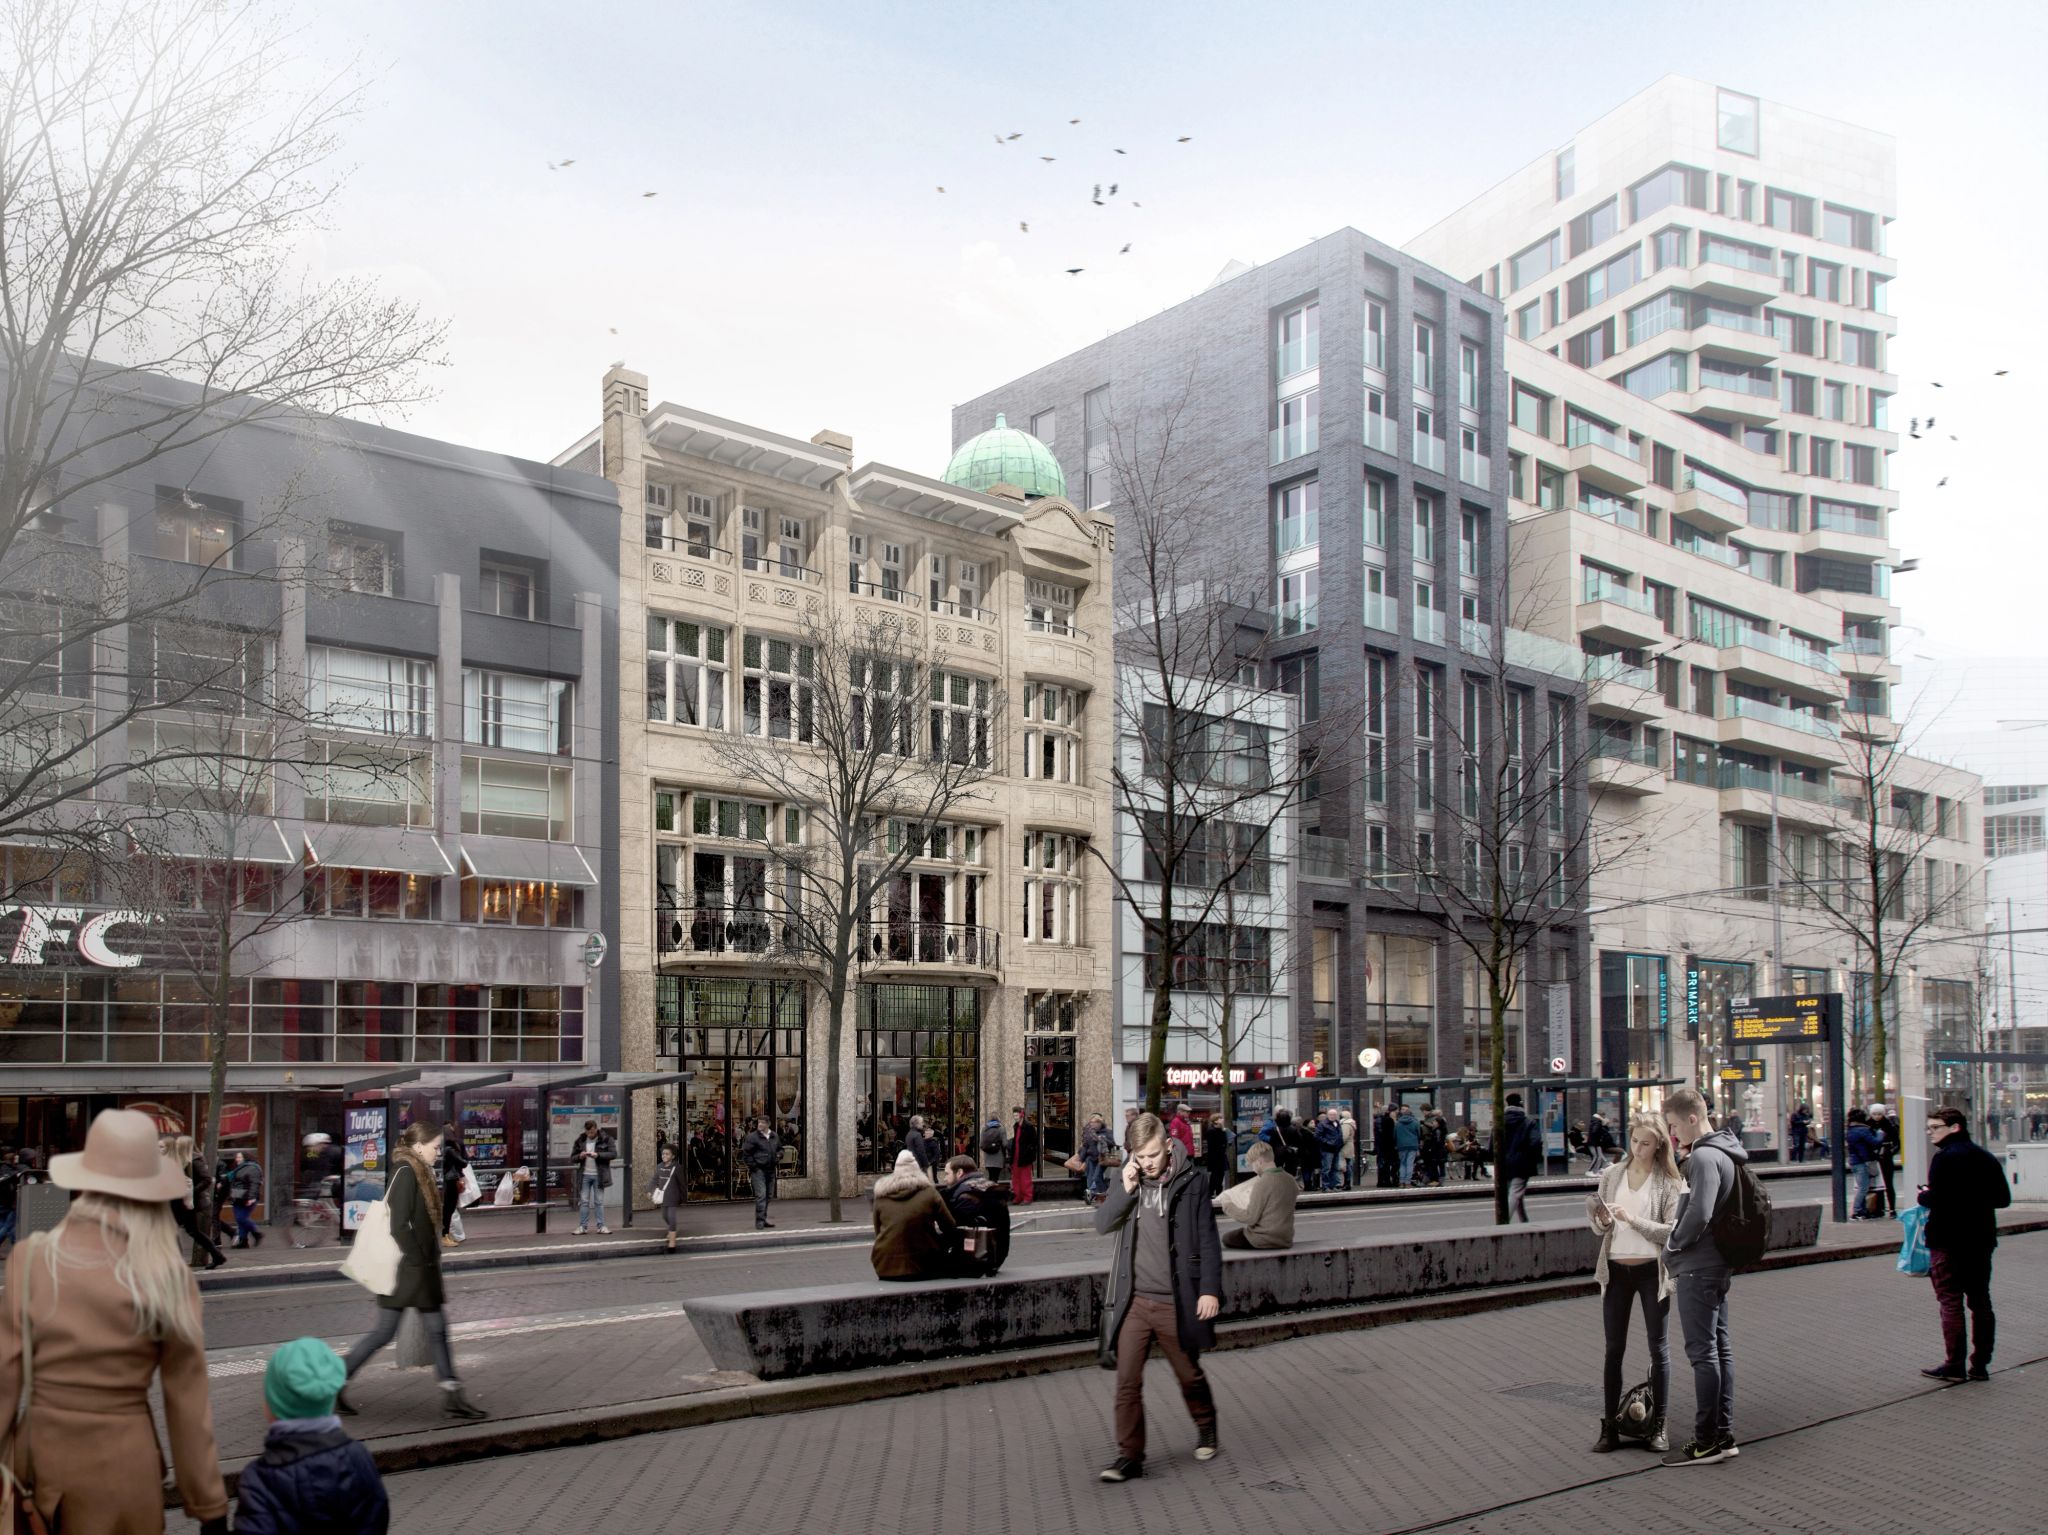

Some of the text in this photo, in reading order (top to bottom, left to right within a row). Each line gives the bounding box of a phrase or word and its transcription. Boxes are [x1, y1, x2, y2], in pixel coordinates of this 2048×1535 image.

[0, 905, 150, 967] FC
[1688, 971, 1698, 1023] PRIMARK
[1239, 1096, 1268, 1110] Turkije
[350, 1111, 383, 1133] Turkije
